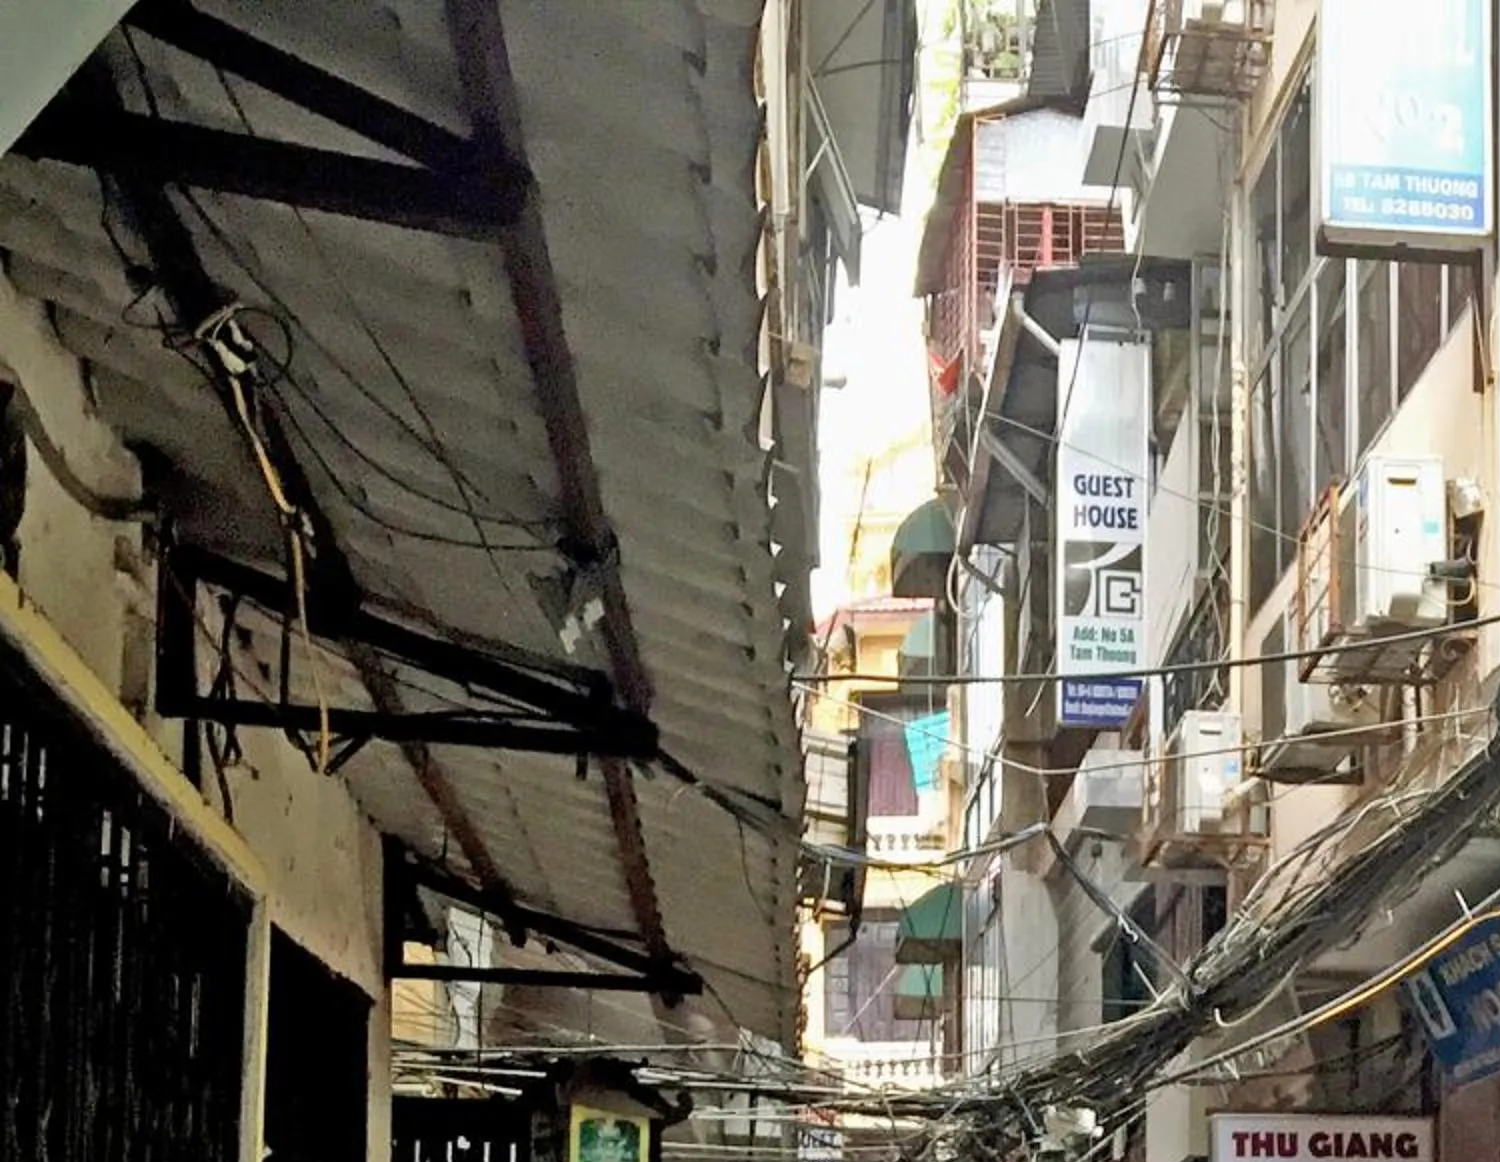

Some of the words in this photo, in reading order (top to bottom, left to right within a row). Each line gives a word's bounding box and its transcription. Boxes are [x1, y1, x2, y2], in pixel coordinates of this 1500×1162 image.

[1073, 473, 1135, 499] GUEST
[1073, 503, 1138, 530] HOUSE
[1073, 625, 1099, 641] Add:
[1232, 1131, 1298, 1158] THU
[1307, 1131, 1419, 1159] GIANG
